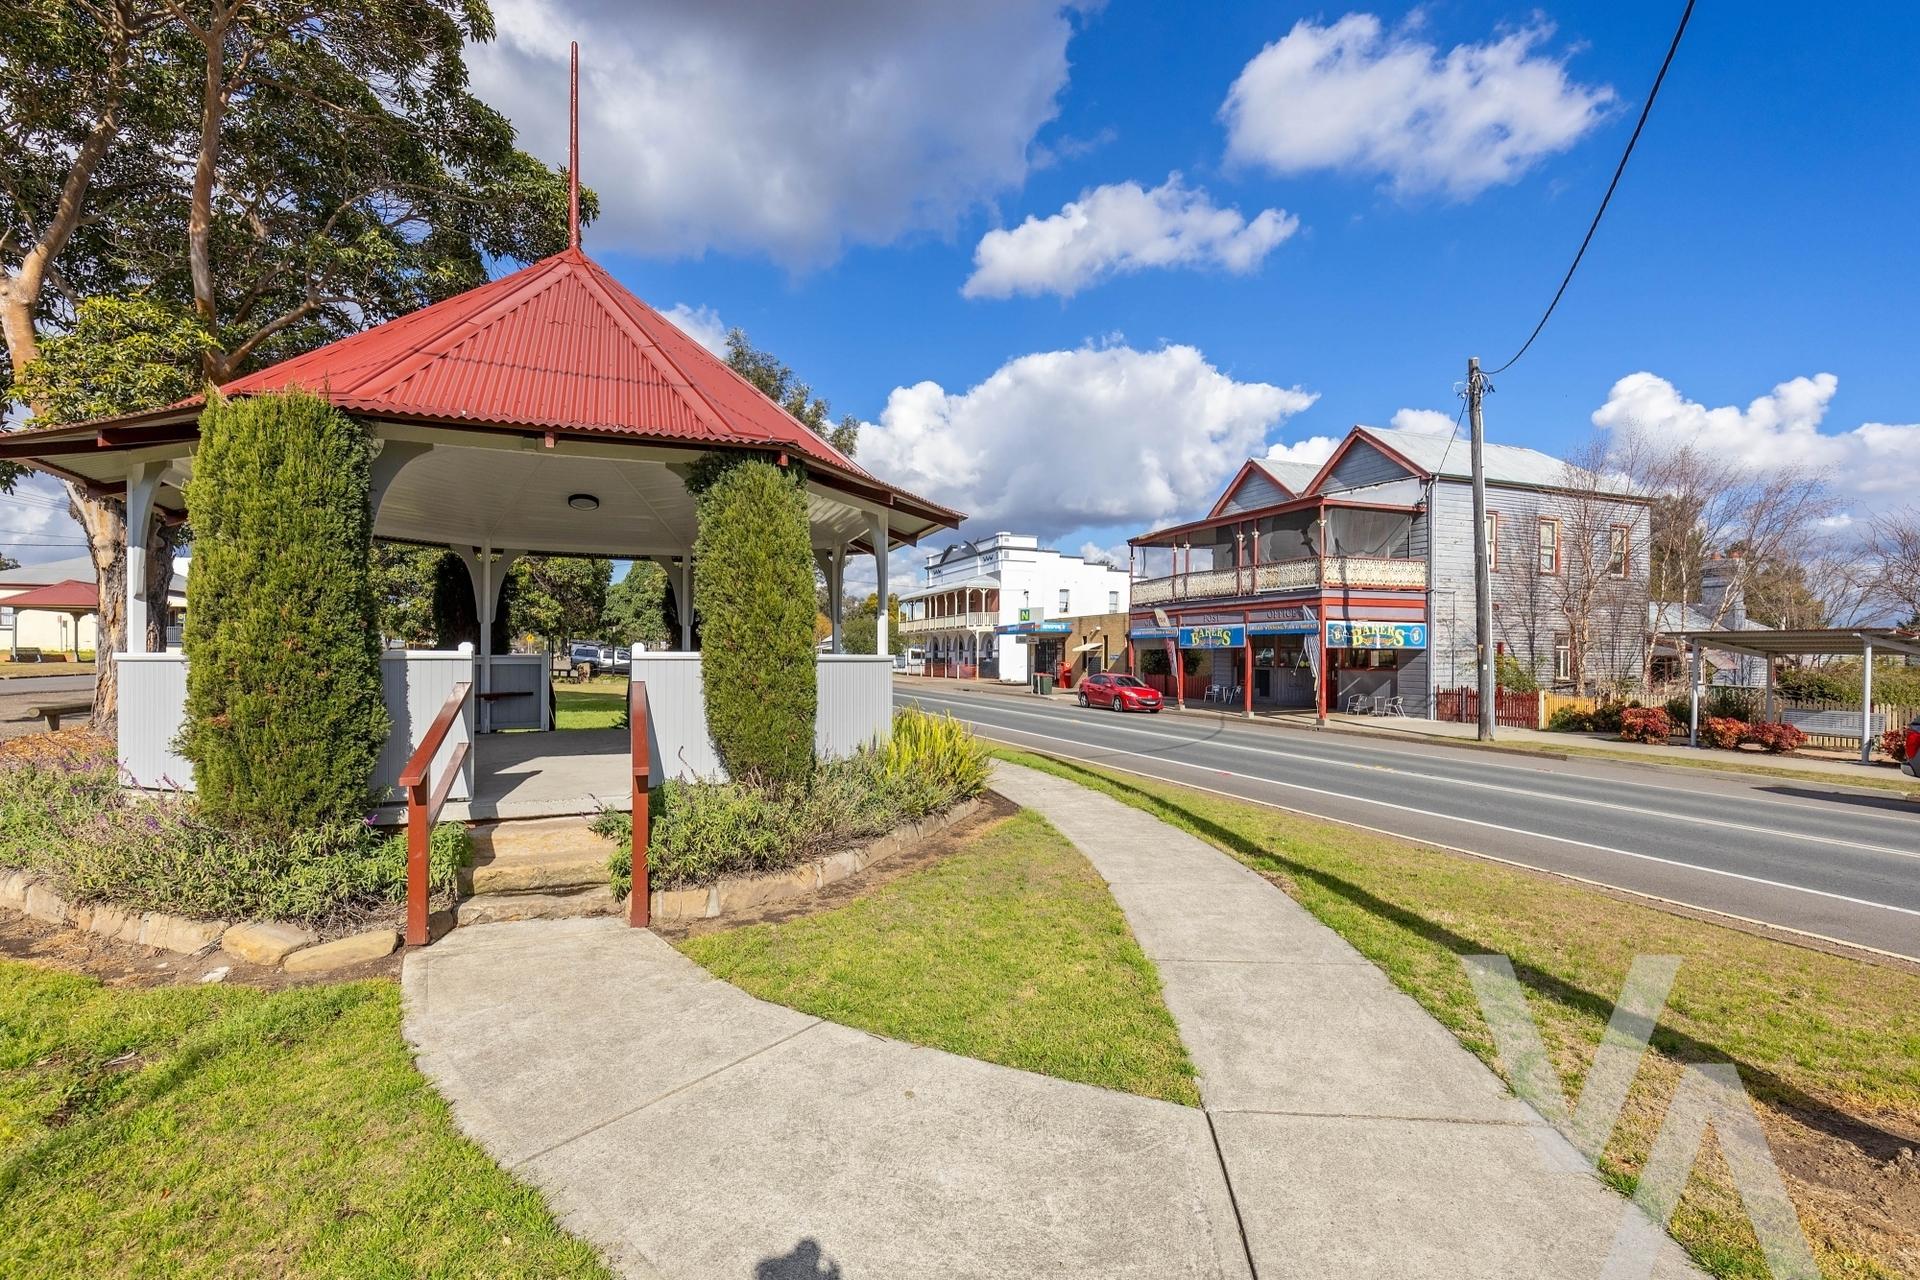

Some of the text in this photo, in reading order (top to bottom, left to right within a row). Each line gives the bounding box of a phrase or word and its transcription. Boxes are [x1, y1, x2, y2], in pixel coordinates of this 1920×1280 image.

[1021, 611, 1029, 620] N
[1267, 608, 1297, 618] OFFICE
[1203, 615, 1219, 623] POST
[1191, 627, 1232, 646] BAKERS
[1352, 624, 1405, 647] BAKERS
